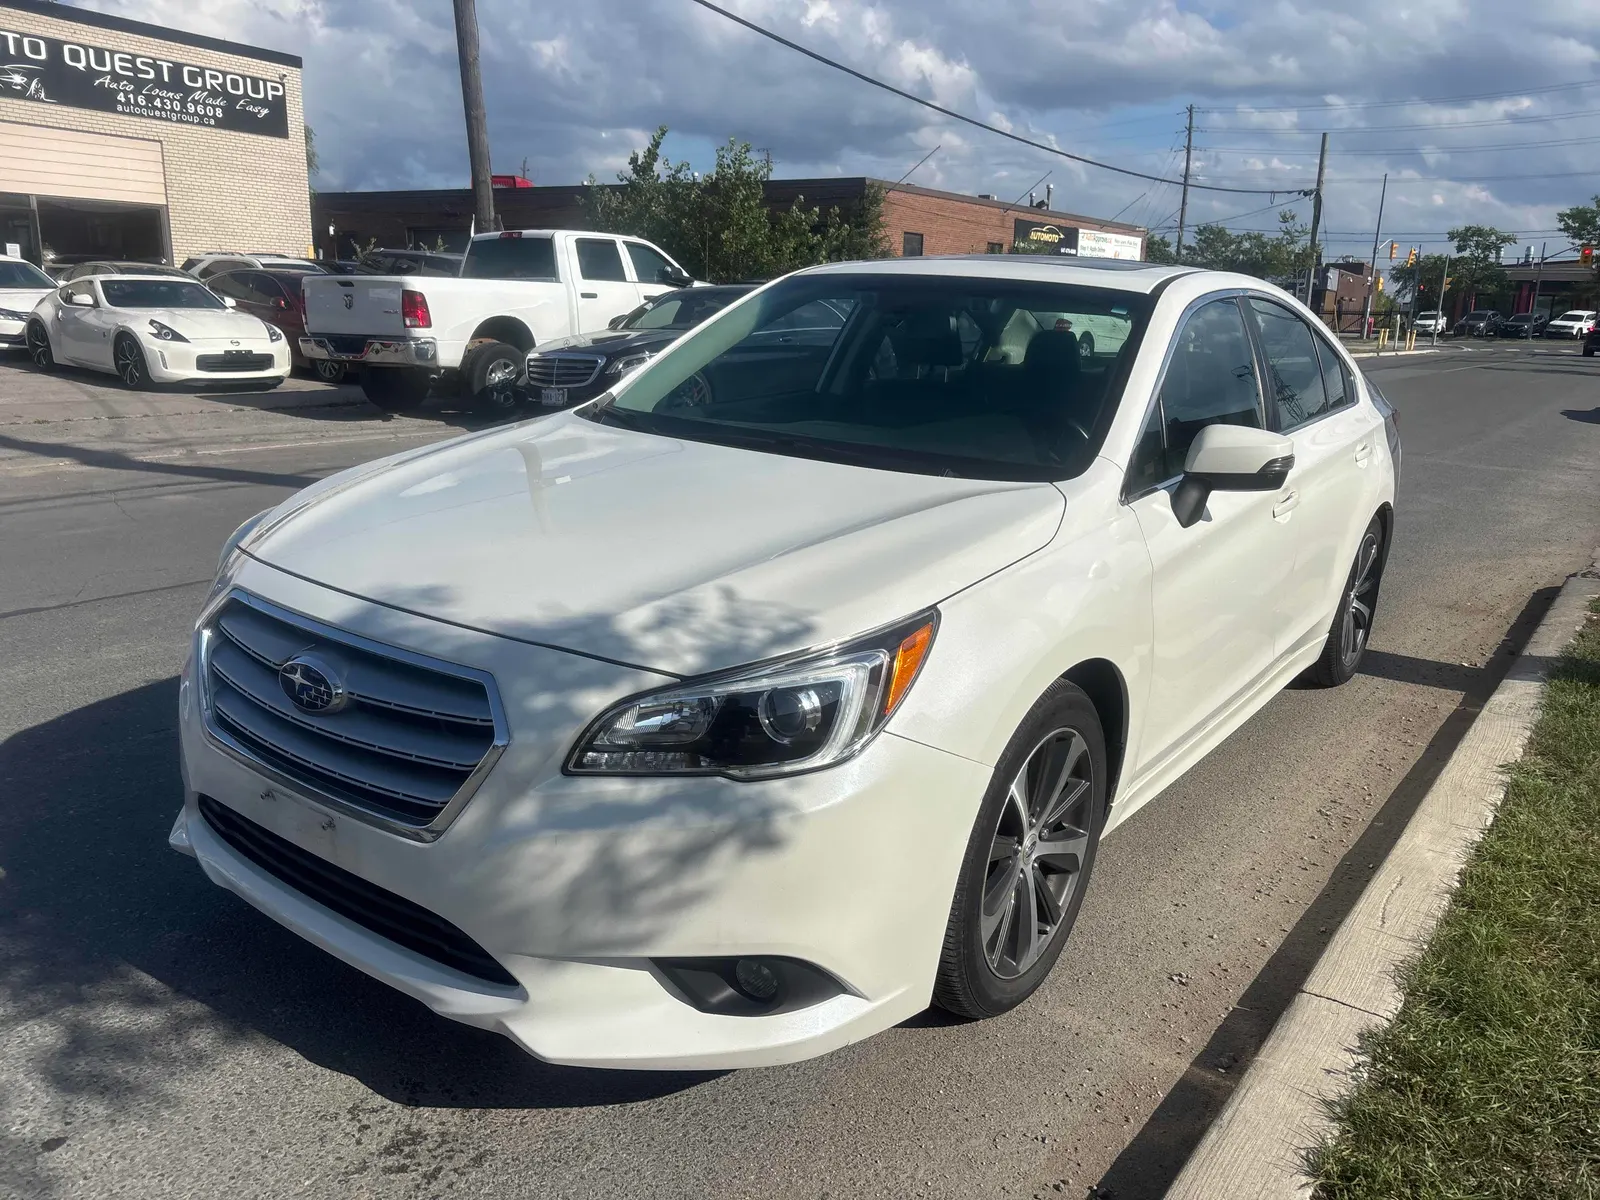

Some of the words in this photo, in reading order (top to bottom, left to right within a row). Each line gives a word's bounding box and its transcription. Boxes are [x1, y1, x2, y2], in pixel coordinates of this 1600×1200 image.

[63, 44, 173, 82] QUEST
[183, 67, 284, 101] GROUP
[94, 75, 134, 91] Auto
[142, 84, 183, 100] Loans
[188, 91, 228, 106] Made
[236, 99, 270, 119] Easy
[117, 92, 223, 118] 416.430.9608
[117, 104, 215, 126] autoquestgroup.ca
[1030, 231, 1059, 243] AUTOMOTO
